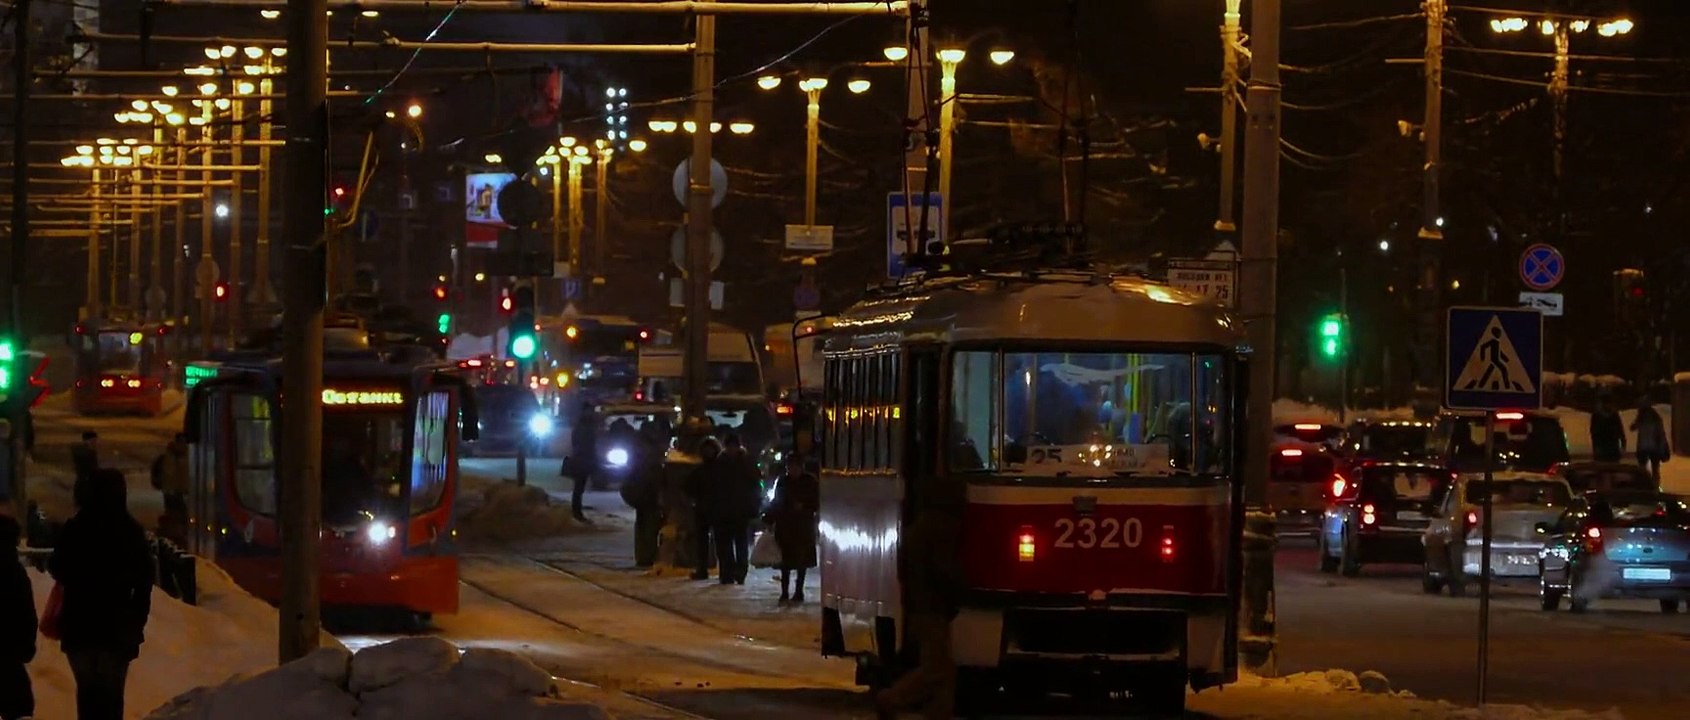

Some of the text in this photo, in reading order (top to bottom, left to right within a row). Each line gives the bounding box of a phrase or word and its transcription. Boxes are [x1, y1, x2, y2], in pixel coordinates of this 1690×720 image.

[1215, 284, 1229, 299] 25
[1031, 448, 1062, 463] 25
[1054, 517, 1142, 548] 2320
